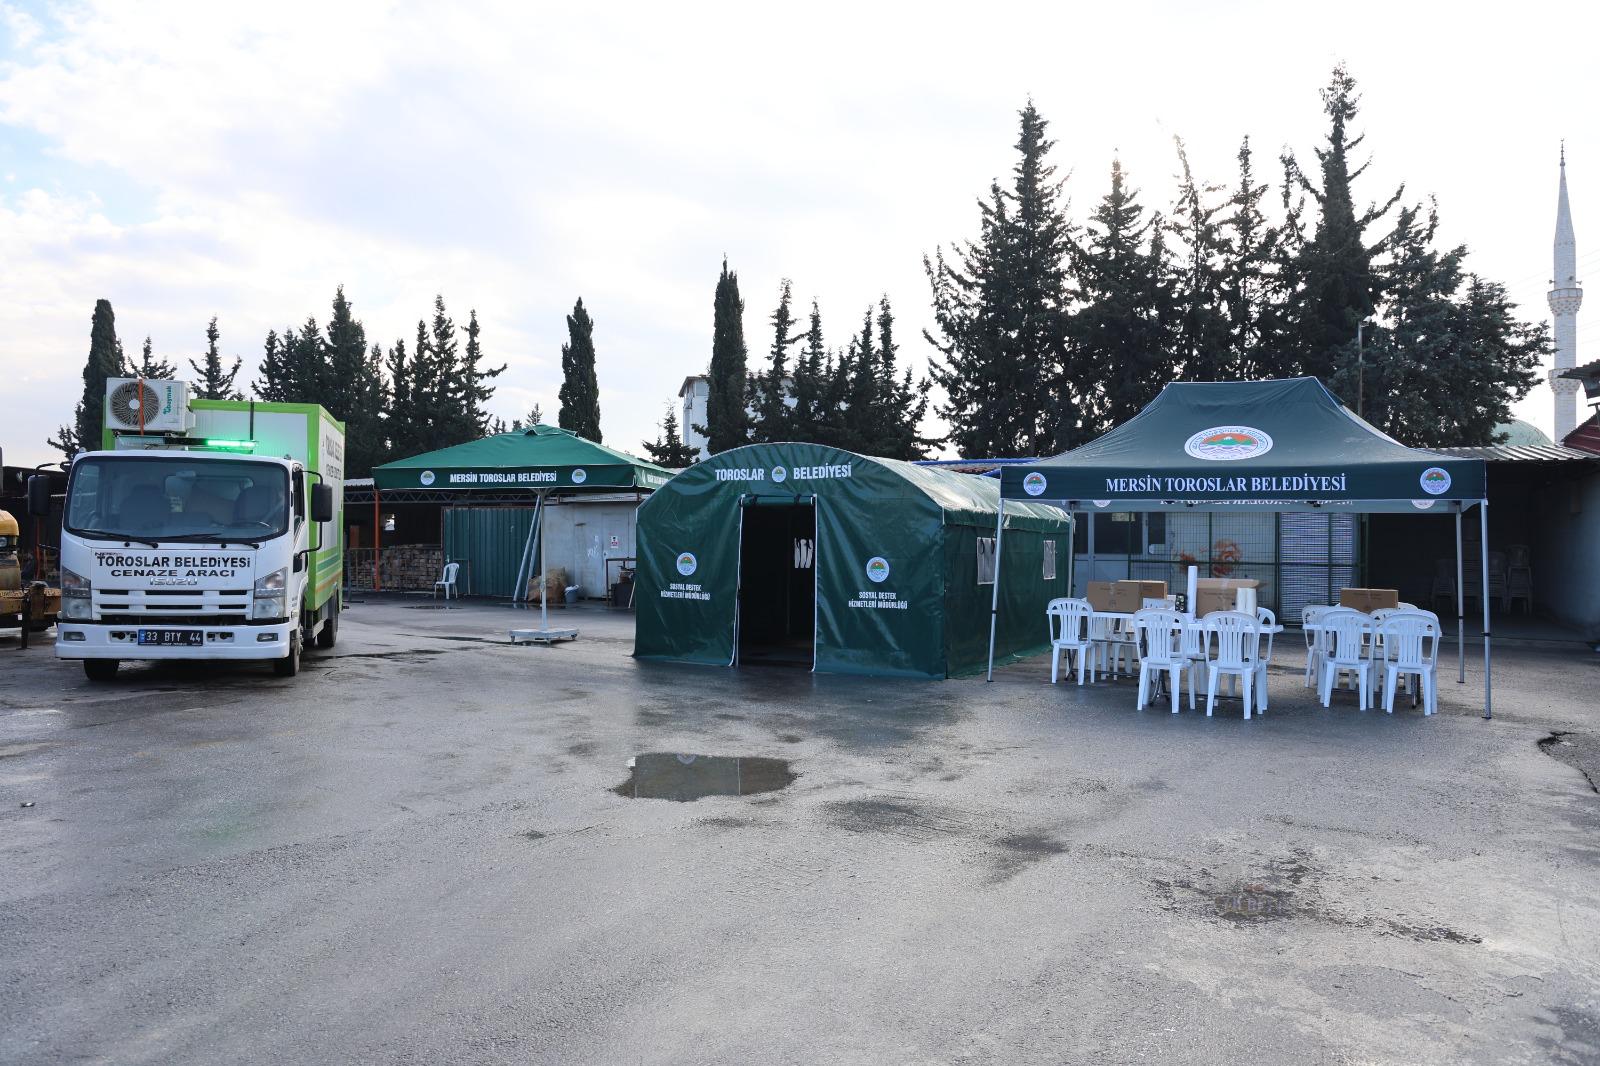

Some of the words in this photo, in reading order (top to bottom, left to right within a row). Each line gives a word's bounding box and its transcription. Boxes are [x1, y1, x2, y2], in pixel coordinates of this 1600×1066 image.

[450, 472, 477, 483] MERSİN
[479, 473, 516, 483] TOROSLAR
[517, 471, 557, 482] BELEDİYESİ
[715, 468, 765, 481] TOROSLAR
[793, 462, 852, 480] BELEDİYESİ
[1105, 474, 1162, 492] MERSİN
[1165, 477, 1248, 492] TOROSLAR
[1251, 473, 1346, 491] BELEDİYESİ
[97, 556, 170, 568] TOROSLAR
[110, 569, 178, 577] CENAZE
[185, 569, 235, 577] ARACI
[149, 577, 198, 586] ISUZU
[859, 591, 877, 599] SOSYAL
[878, 592, 897, 600] DESTEK
[146, 632, 158, 641] 33
[164, 632, 182, 642] BTY
[189, 632, 201, 642] 44
